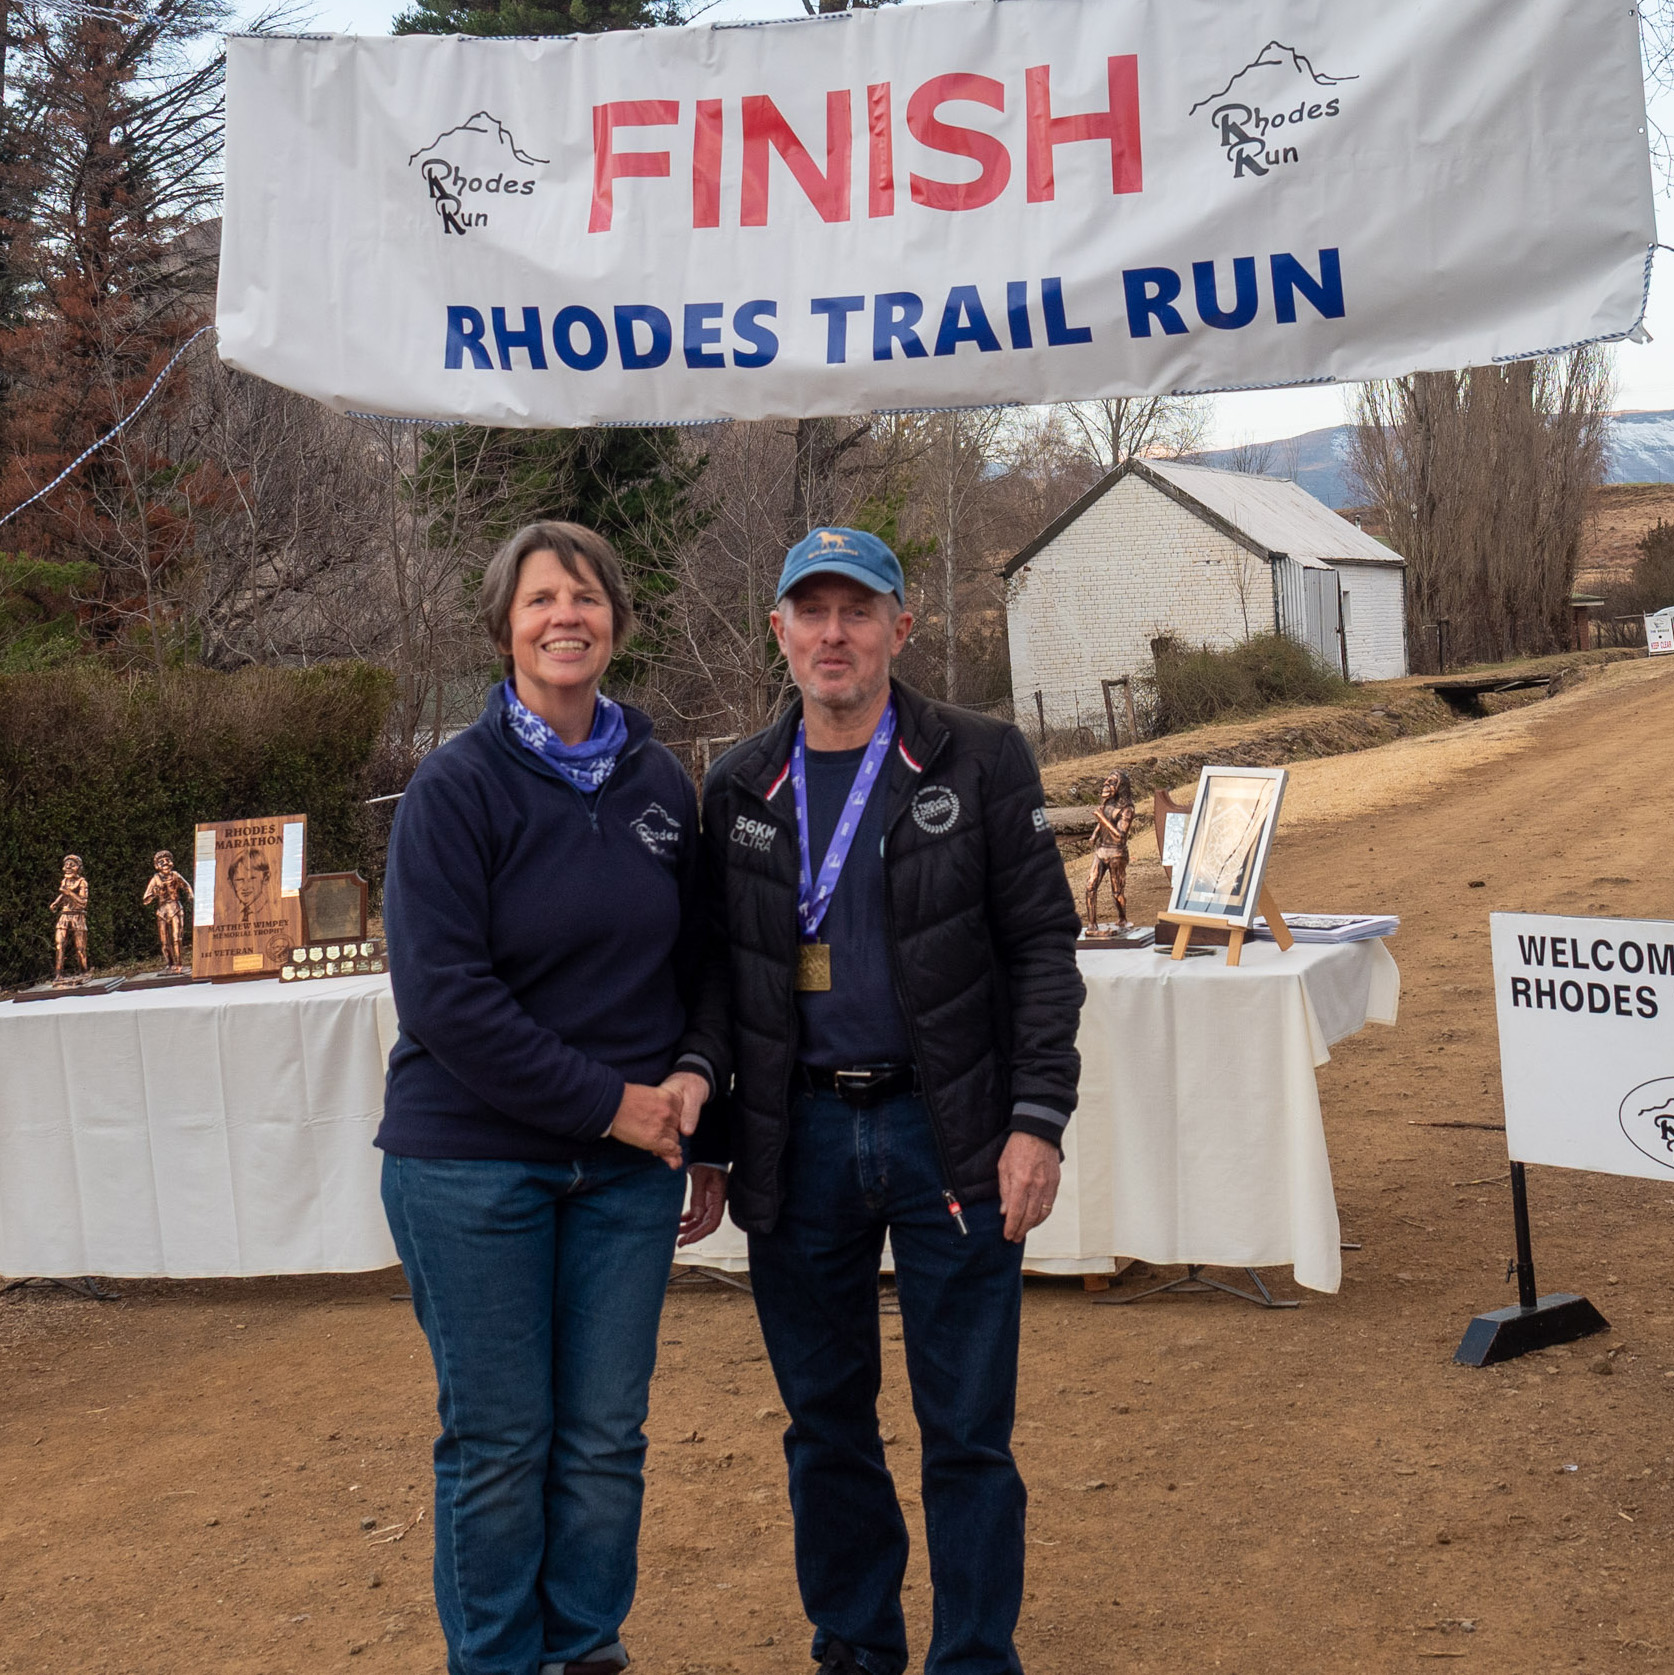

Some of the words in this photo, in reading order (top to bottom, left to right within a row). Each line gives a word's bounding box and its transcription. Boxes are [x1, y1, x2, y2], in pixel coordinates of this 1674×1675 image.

[1211, 98, 1340, 147] Rhodes
[588, 54, 1143, 234] FINISH
[1227, 137, 1299, 178] Run
[421, 158, 536, 198] Rhodes
[435, 193, 489, 235] Run
[444, 301, 779, 372] RHODES
[811, 277, 1093, 364] TRAIL
[1123, 248, 1345, 337] RUN
[215, 835, 284, 850] MARATHON
[224, 824, 276, 838] RHODES
[729, 828, 772, 853] ULTRA
[734, 814, 778, 841] 56KM
[207, 922, 252, 933] MATTHEW
[253, 919, 289, 929] WIMPEY
[212, 930, 252, 940] MEMORIAL
[254, 927, 285, 936] TROPHY
[213, 946, 254, 957] VETERAN
[1511, 976, 1659, 1019] RHODES
